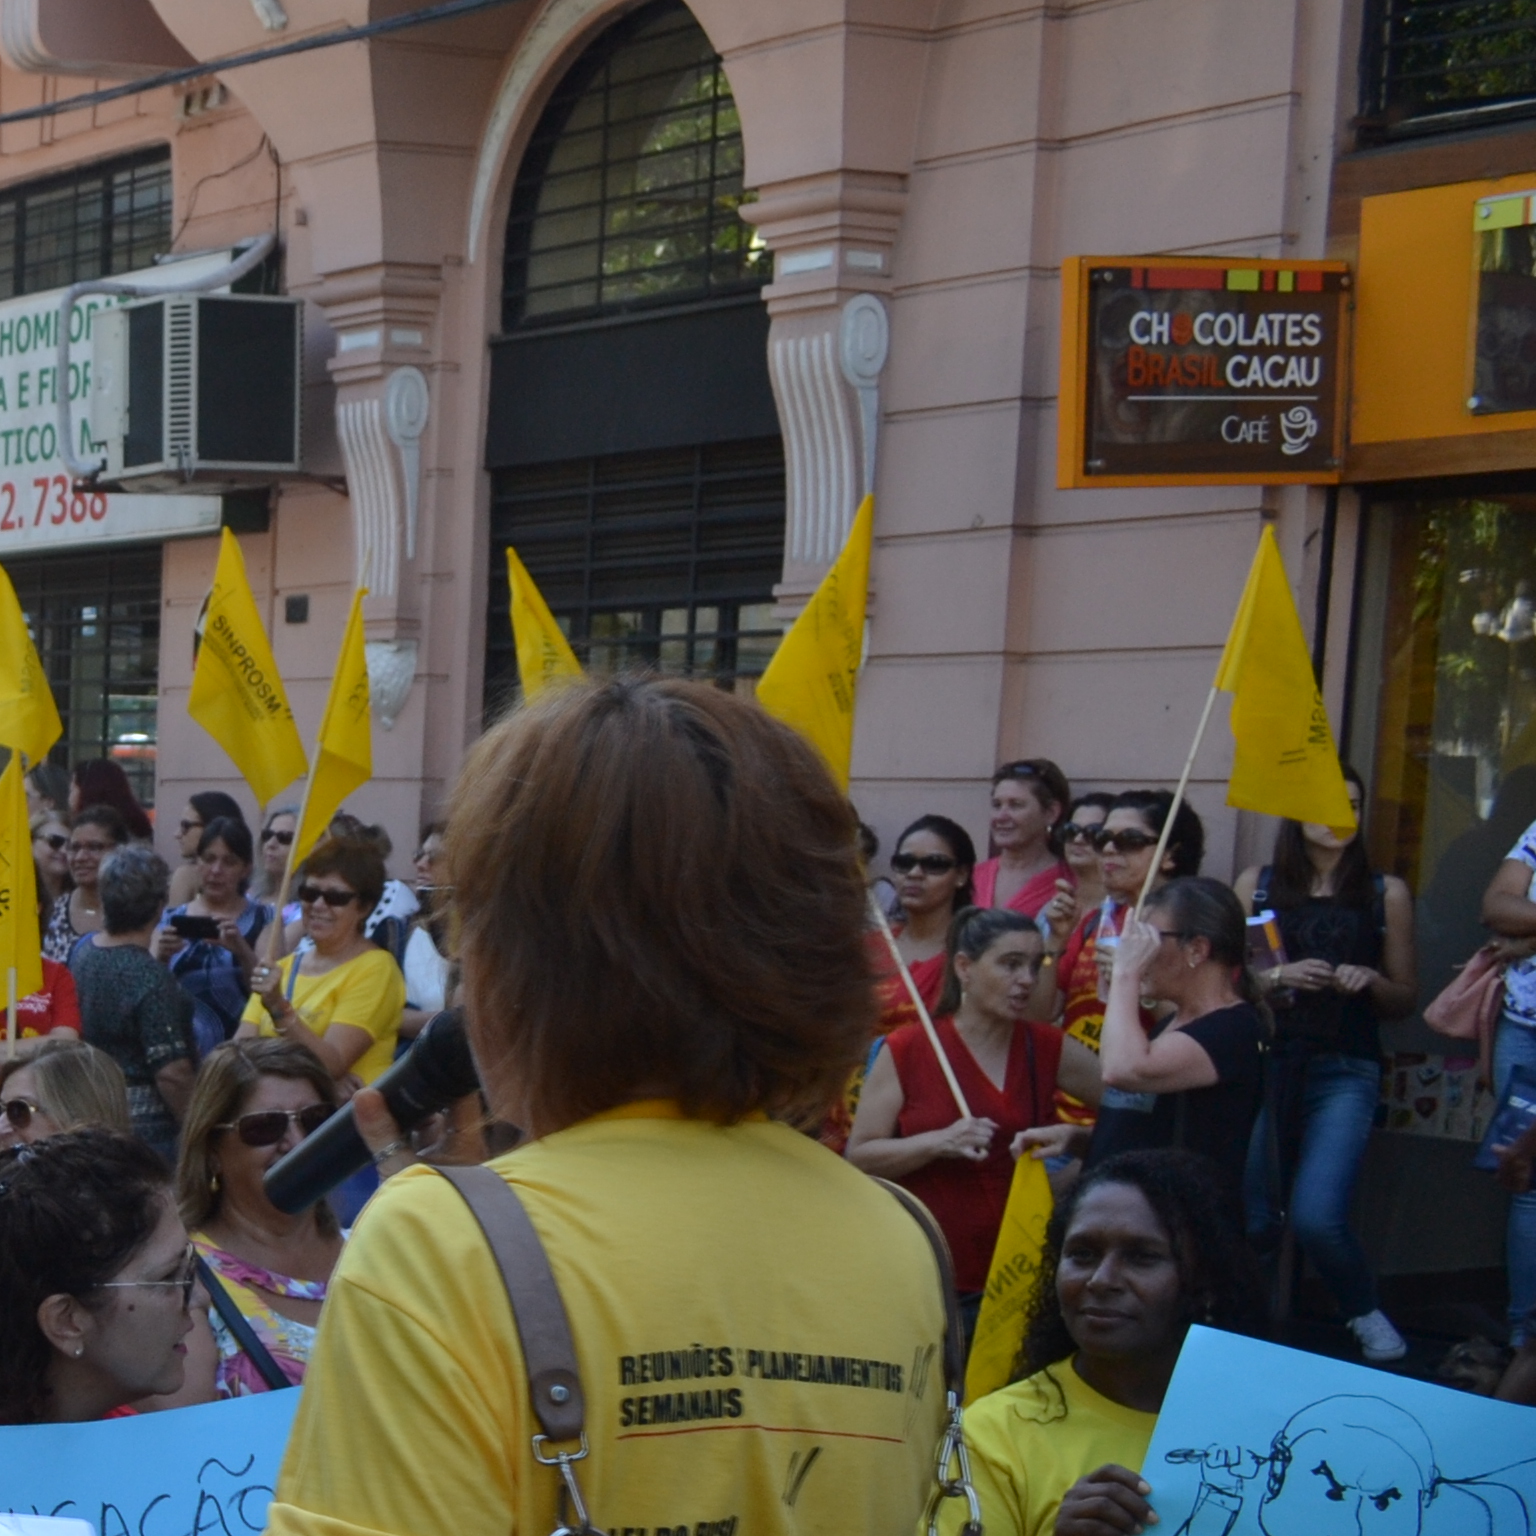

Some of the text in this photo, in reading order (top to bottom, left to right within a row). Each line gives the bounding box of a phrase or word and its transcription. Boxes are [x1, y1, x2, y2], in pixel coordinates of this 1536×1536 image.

[1129, 311, 1321, 347] CHOCOLATES
[18, 371, 29, 409] E
[1226, 355, 1320, 388] CACAU
[213, 614, 282, 714] SINPROSM
[618, 1343, 905, 1393] REUNIÕES PLANEJAMENTOS
[619, 1387, 744, 1427] SEMANAIS
